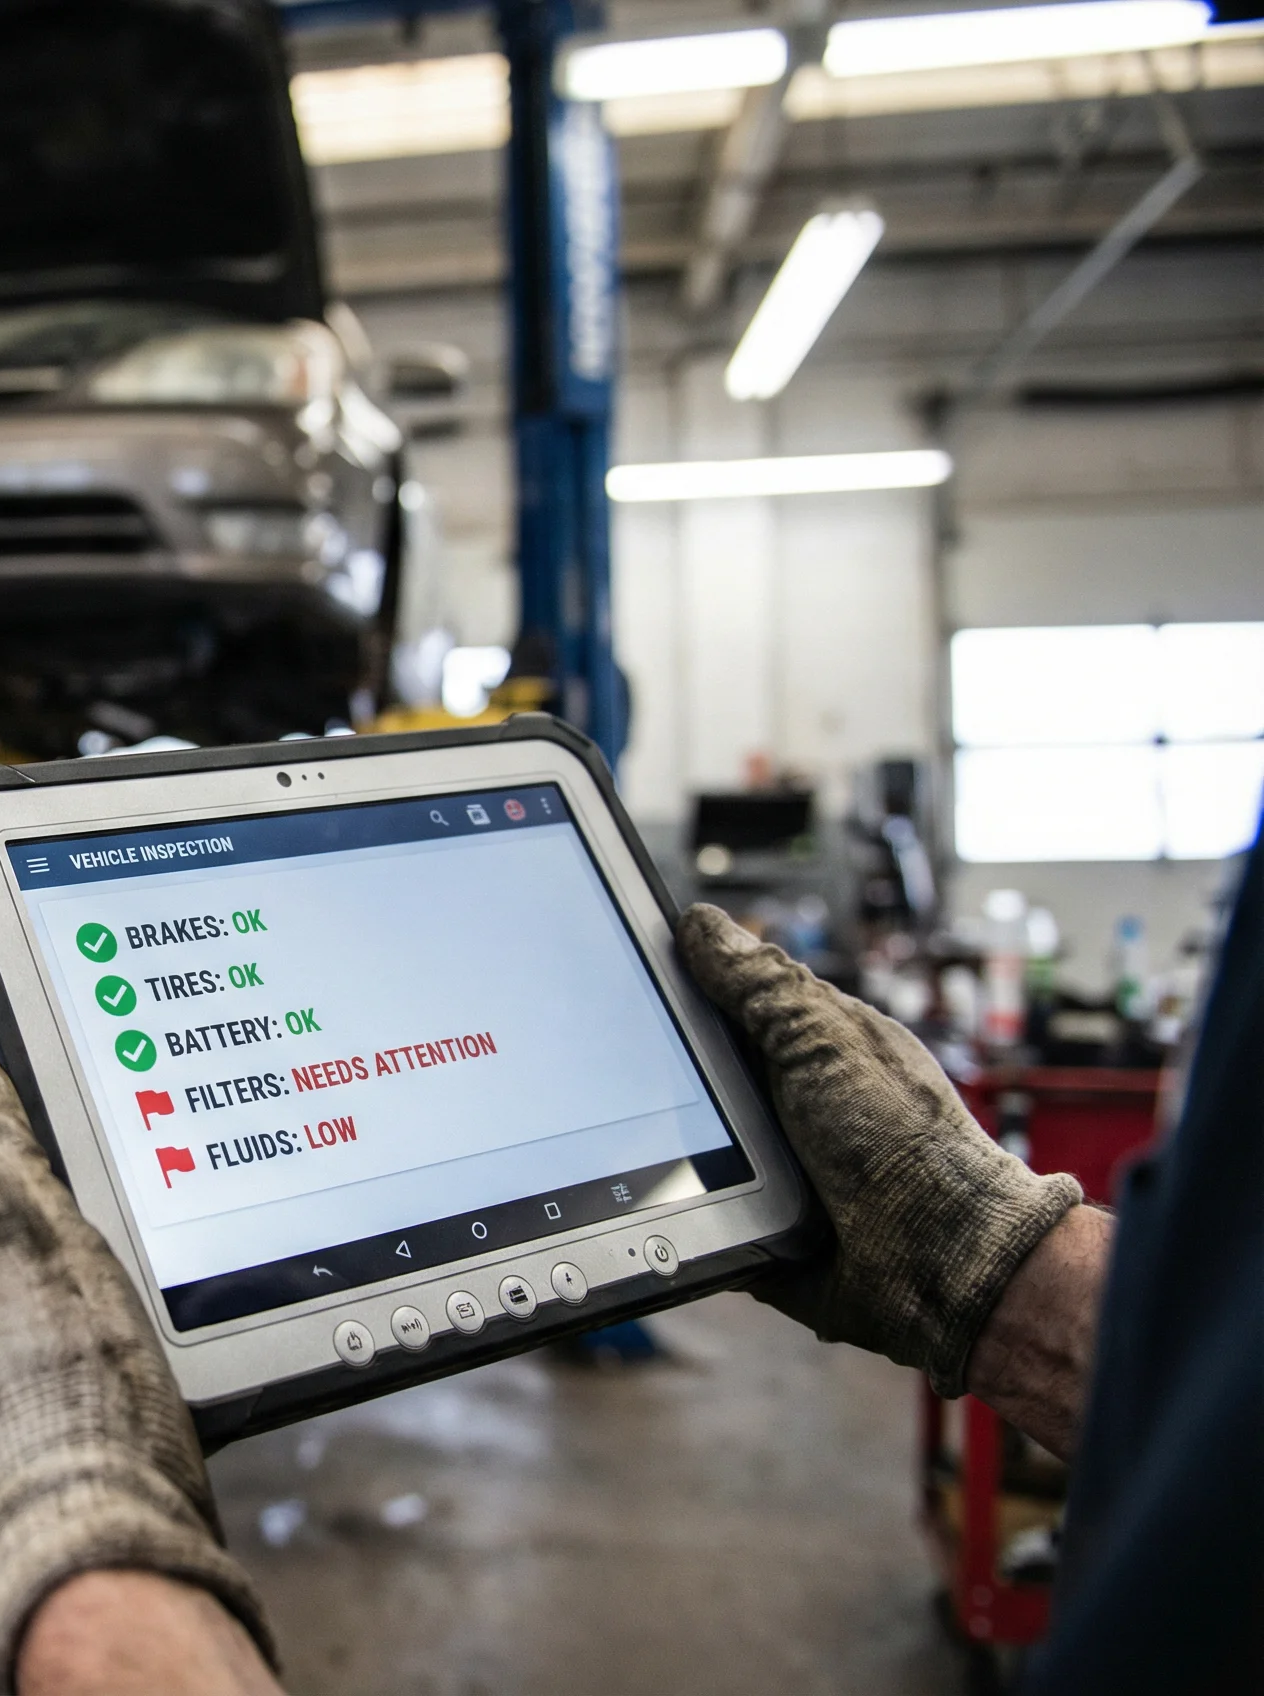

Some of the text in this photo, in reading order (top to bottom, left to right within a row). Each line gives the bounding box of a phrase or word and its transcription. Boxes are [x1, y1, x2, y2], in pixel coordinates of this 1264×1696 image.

[69, 836, 234, 870] VEHICLE INSPECTION
[125, 908, 268, 950] BRAKES: OK
[144, 962, 265, 1002] TIRES: OK
[165, 1007, 322, 1057] BATTERY: OK
[185, 1031, 498, 1114] FILTERS: NEEDS ATTENTION
[206, 1115, 358, 1171] FLUIDS: LOW
